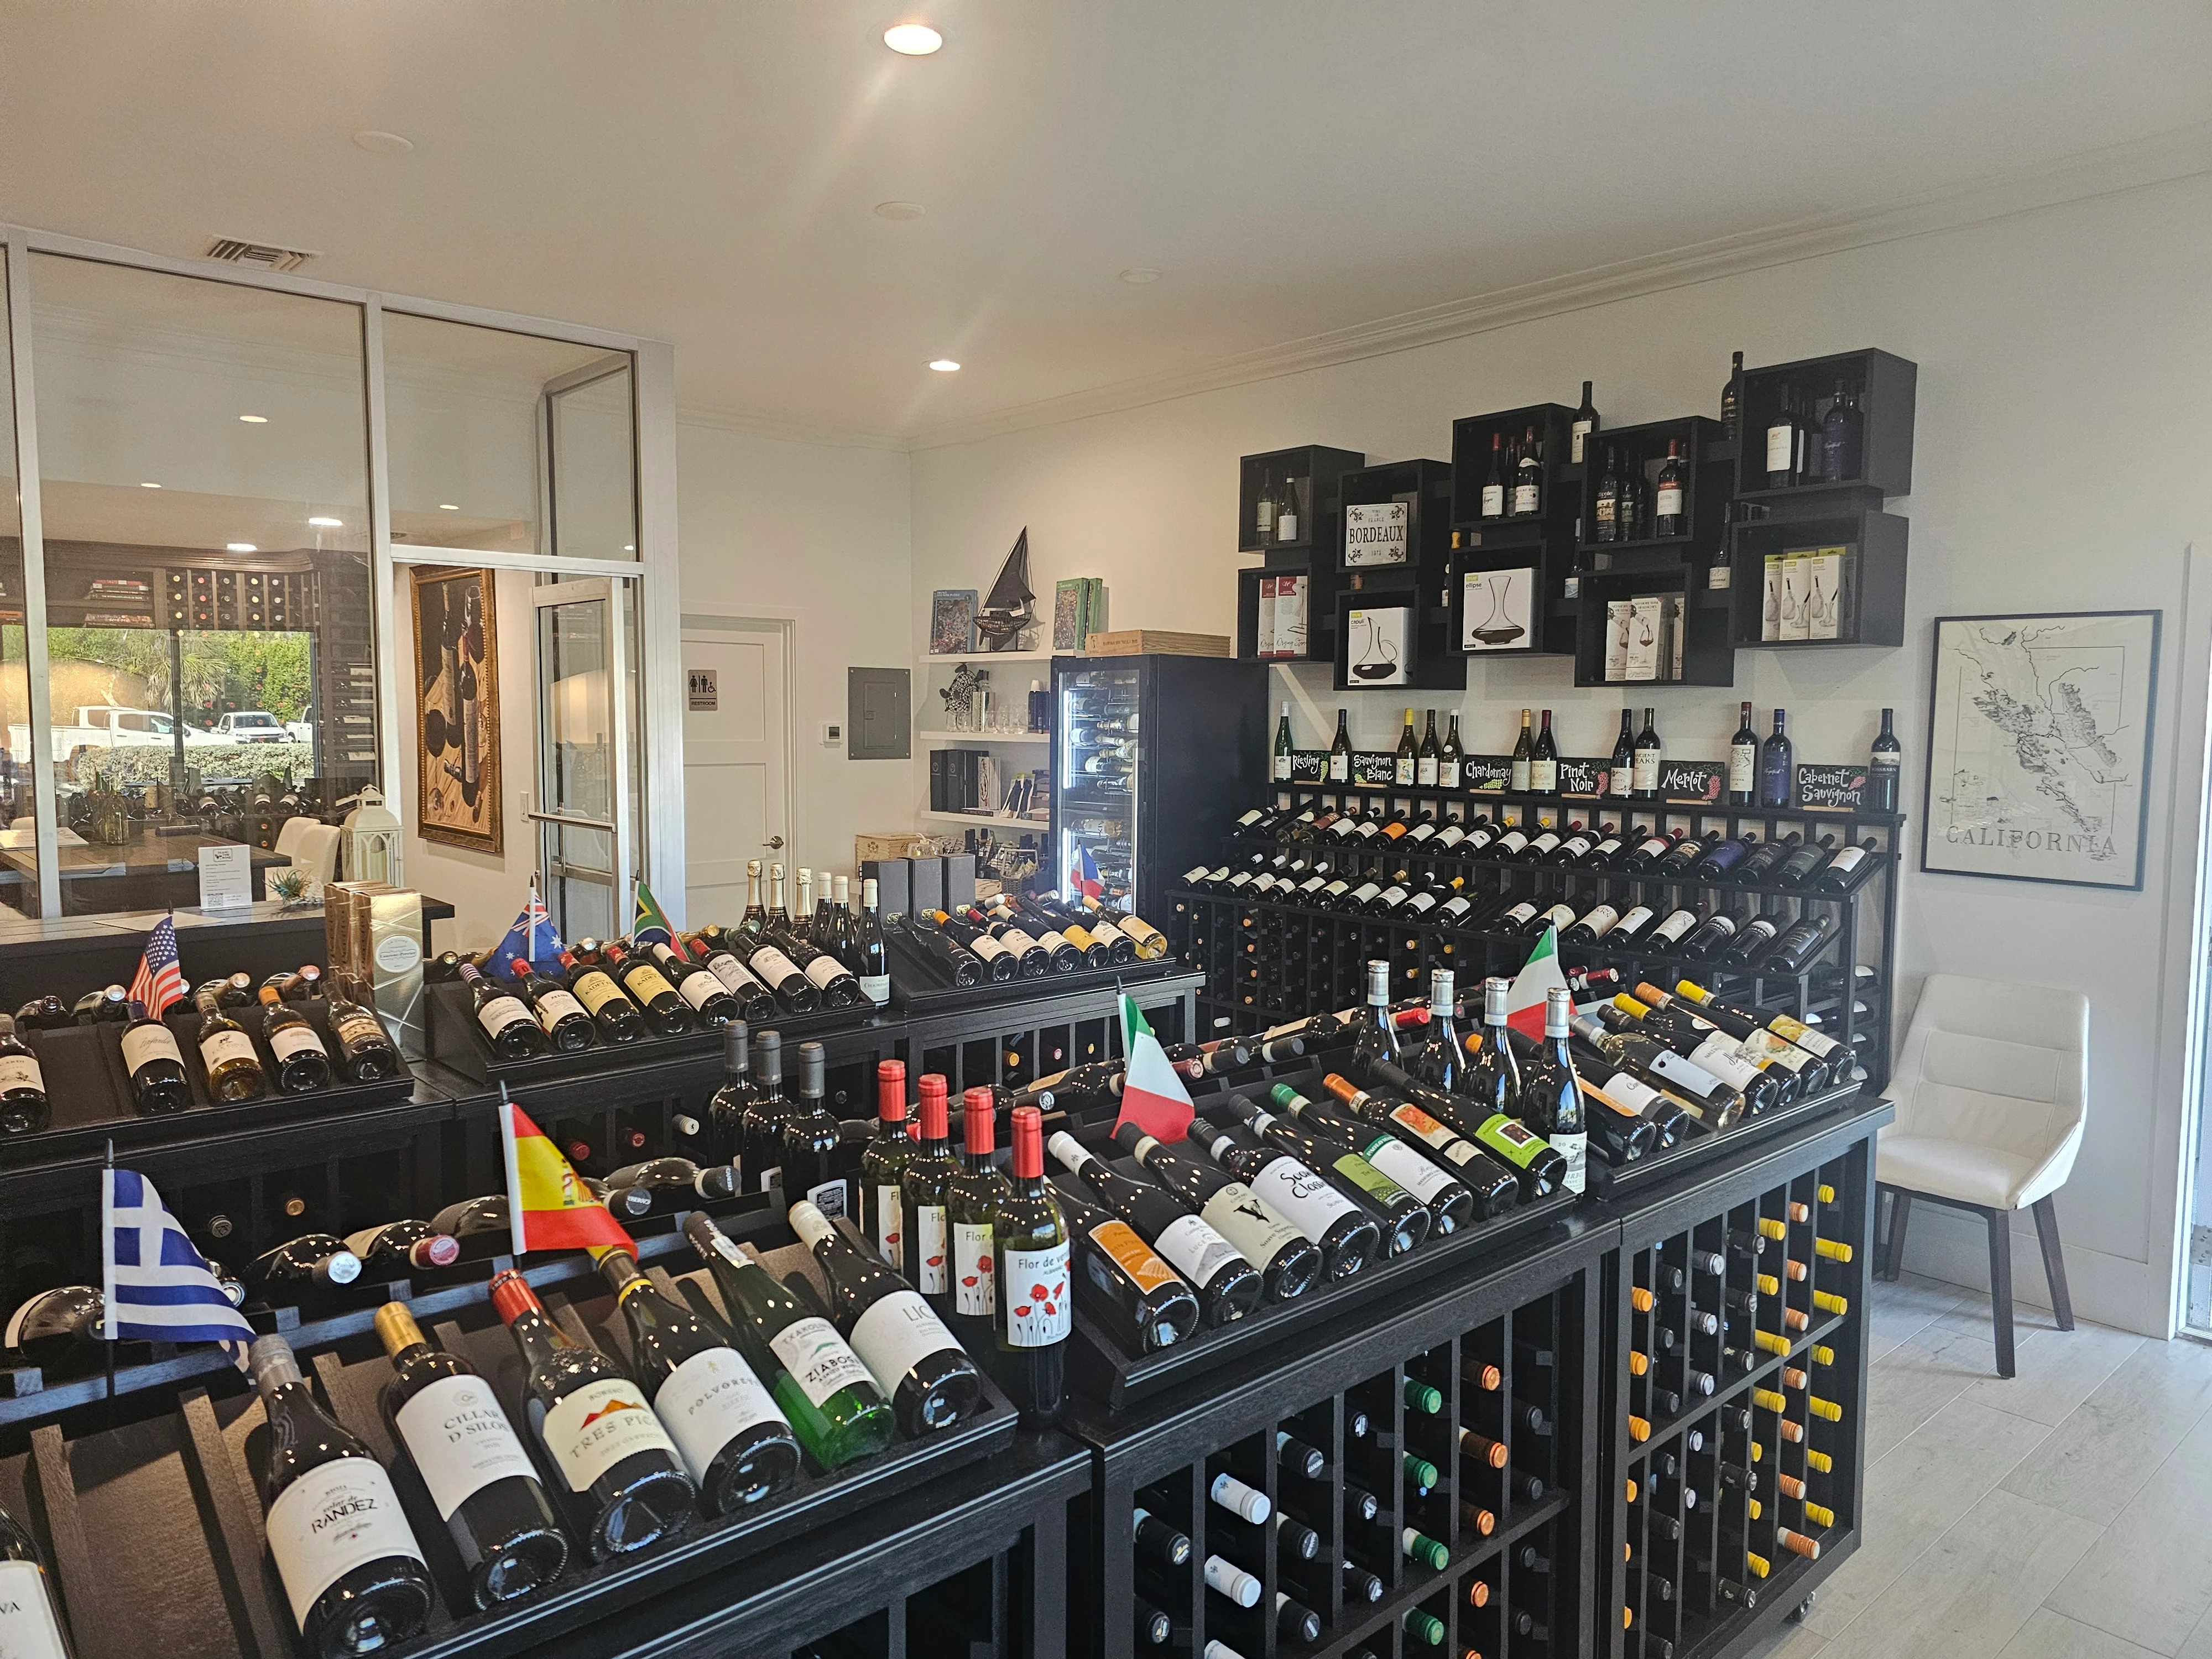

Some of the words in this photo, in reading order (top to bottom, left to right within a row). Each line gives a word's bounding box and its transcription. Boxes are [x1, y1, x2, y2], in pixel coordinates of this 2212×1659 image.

[1349, 525, 1404, 544] BORDEAUX
[1292, 754, 1319, 775] Riesling
[1353, 754, 1393, 770] Sauvignon
[1559, 761, 1590, 780] Pinot
[1366, 768, 1394, 781] Blanc
[1465, 761, 1512, 786] Chardonnay
[1661, 768, 1707, 792] Merlot
[1798, 767, 1850, 788] Cabernet
[1570, 778, 1594, 792] Noir
[1802, 785, 1861, 808] Sauvignon
[1946, 826, 2118, 855] CALIFORNIA
[966, 1232, 986, 1242] Flor
[1018, 1259, 1040, 1270] Flor
[1042, 1256, 1054, 1267] de
[568, 1421, 617, 1459] TRES
[311, 1498, 378, 1534] RANDEZ
